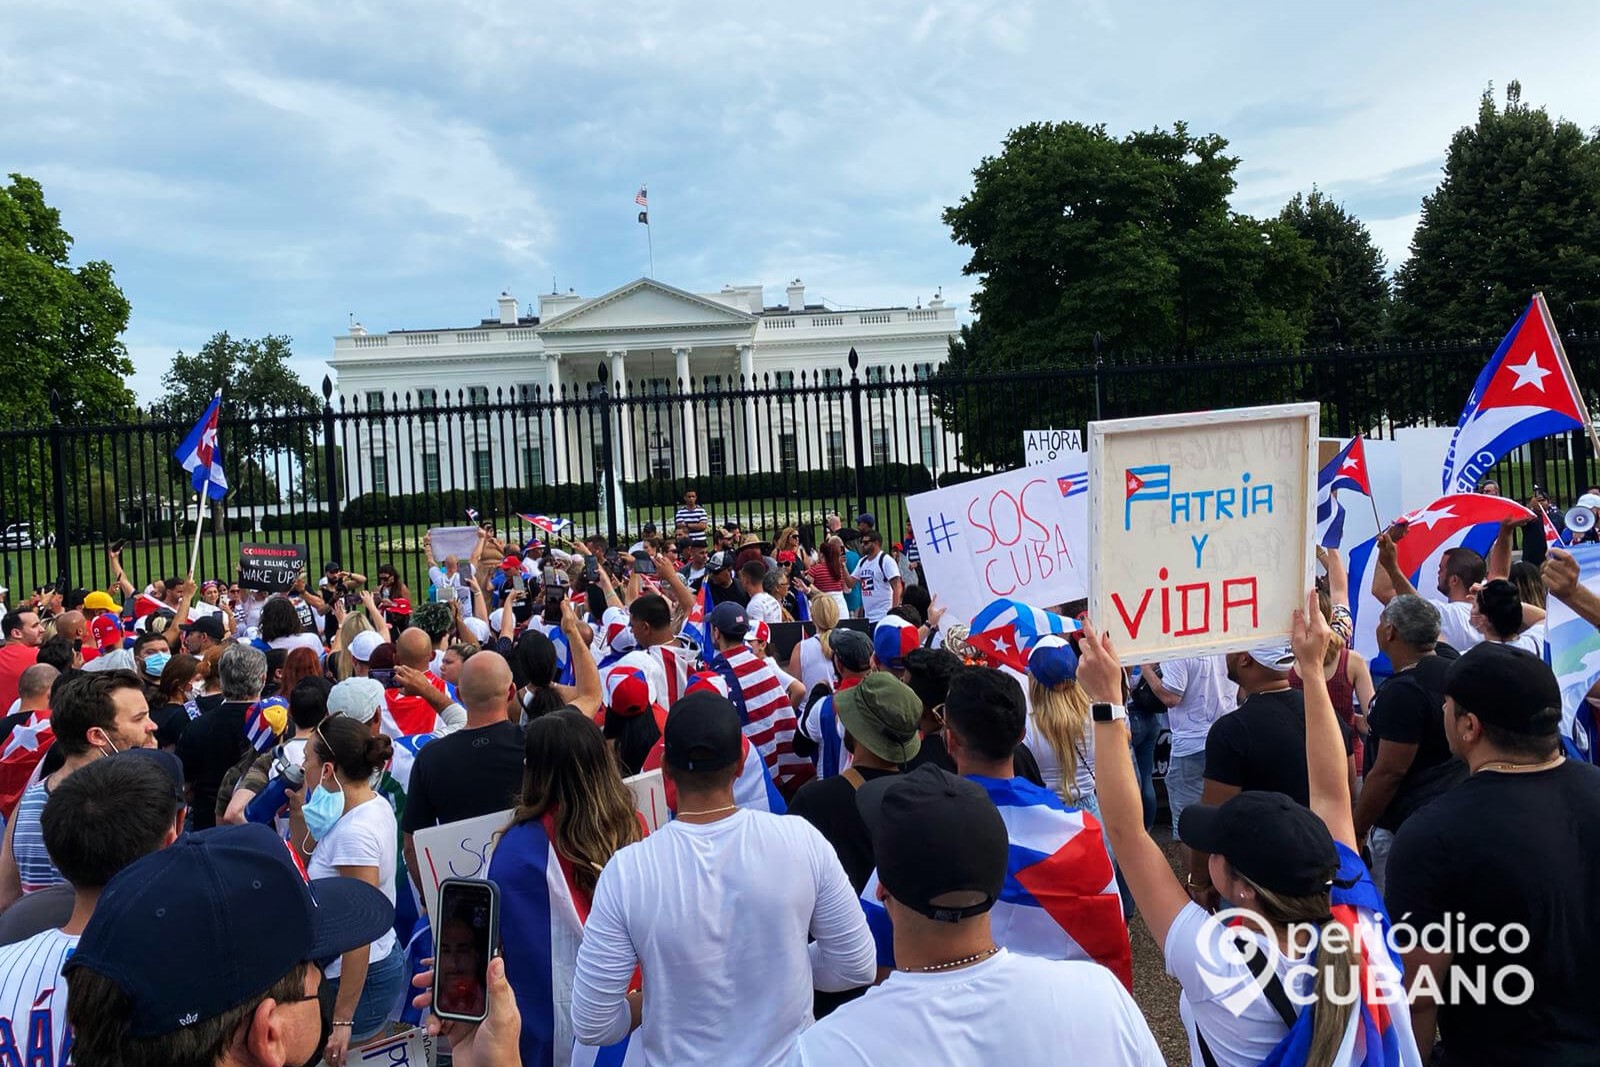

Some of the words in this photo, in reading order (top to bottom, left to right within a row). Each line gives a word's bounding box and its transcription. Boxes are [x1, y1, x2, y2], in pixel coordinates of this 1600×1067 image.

[1027, 431, 1081, 451] AHORA
[968, 479, 1051, 554] SOS
[243, 547, 297, 557] COMMUNISTS
[985, 523, 1074, 597] CUBA
[1191, 534, 1209, 569] Y
[263, 559, 289, 569] KILLING
[242, 569, 272, 584] WAKE
